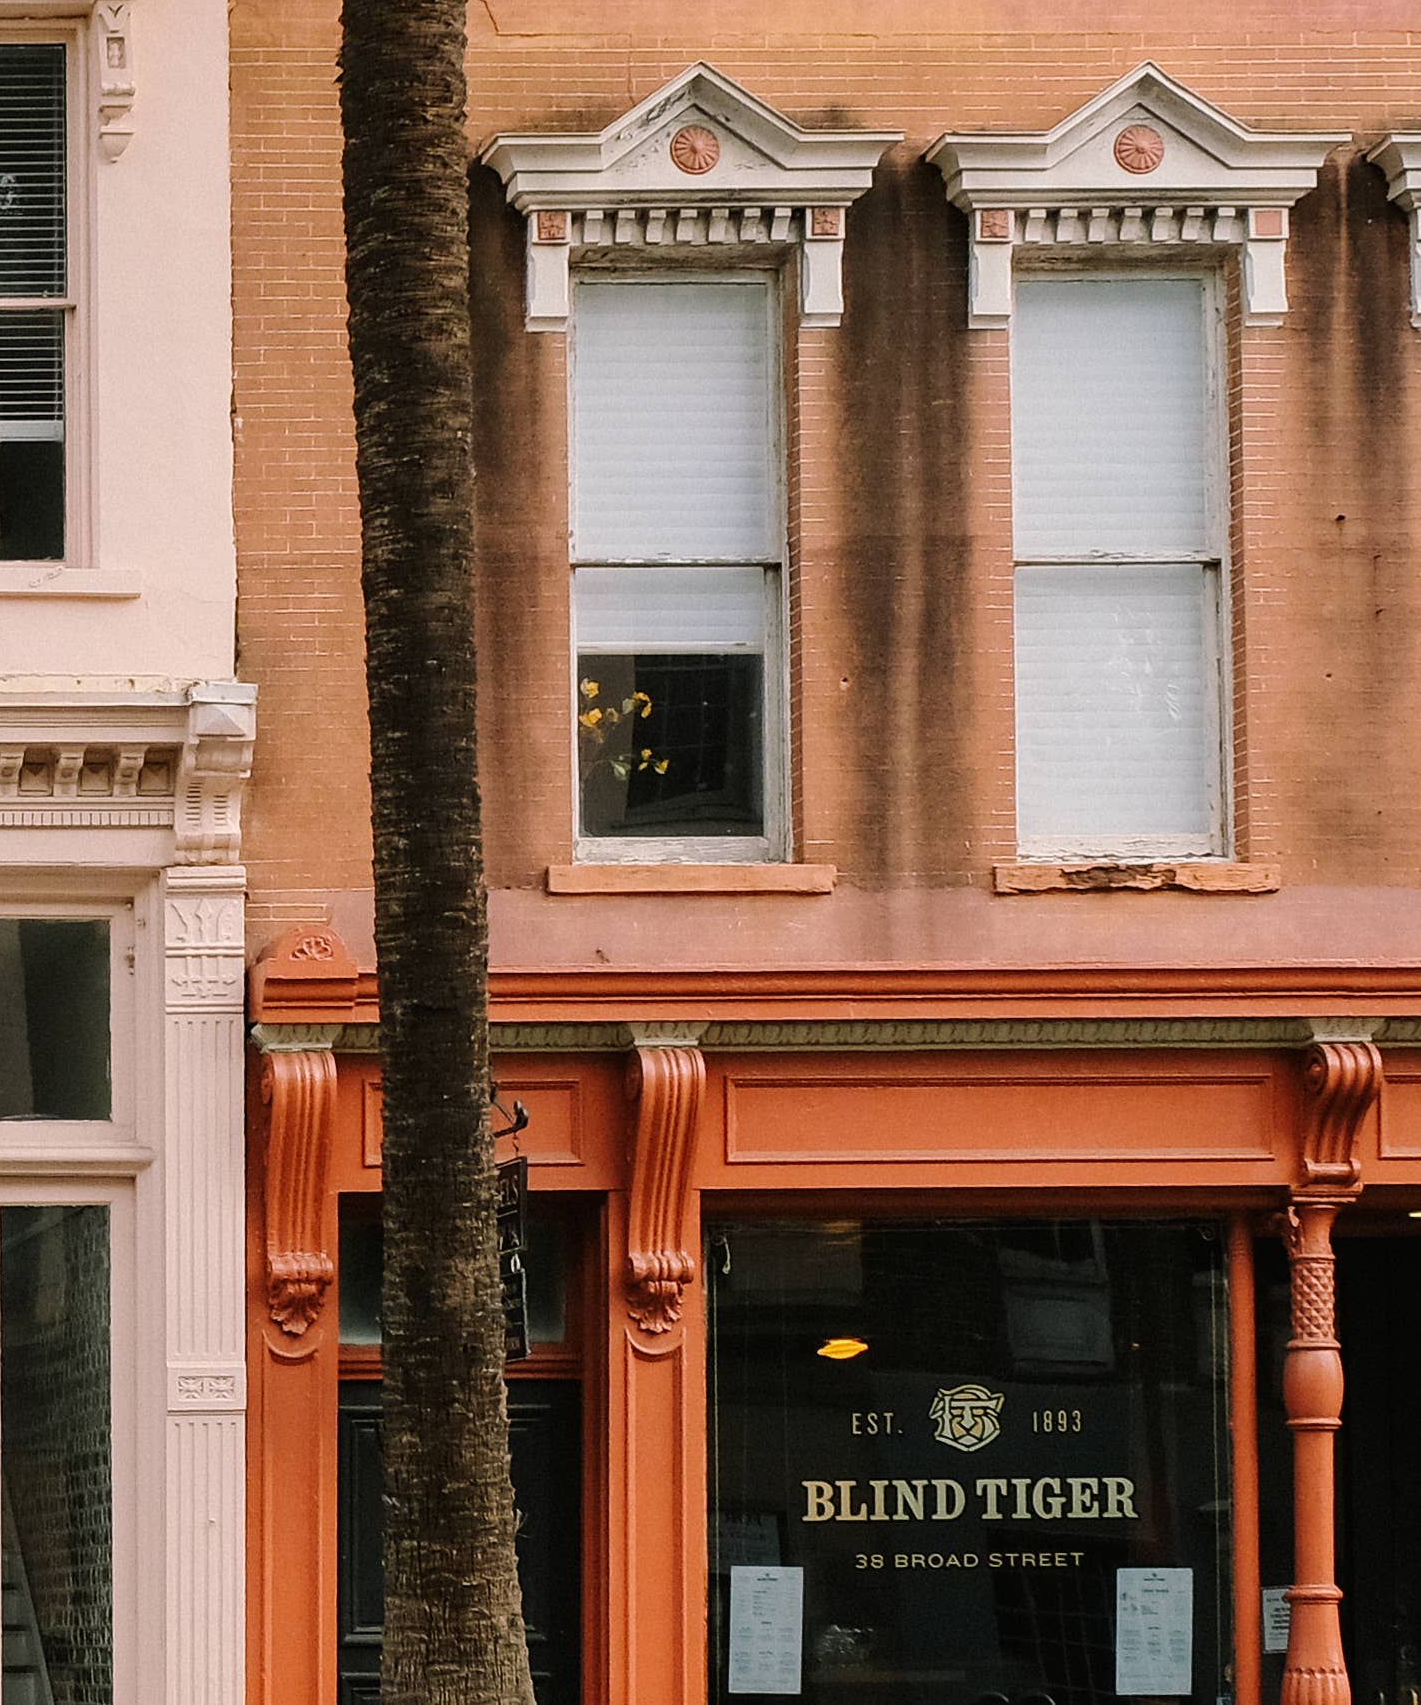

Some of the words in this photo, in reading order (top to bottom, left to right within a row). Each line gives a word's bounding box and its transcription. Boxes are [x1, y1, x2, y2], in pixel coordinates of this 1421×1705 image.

[851, 1412, 904, 1435] EST.
[1032, 1410, 1083, 1433] 1893
[801, 1480, 966, 1522] BLIND
[976, 1477, 1139, 1520] TIGER
[855, 1553, 884, 1569] 38
[895, 1552, 979, 1569] BROAD
[988, 1551, 1085, 1568] STREET
